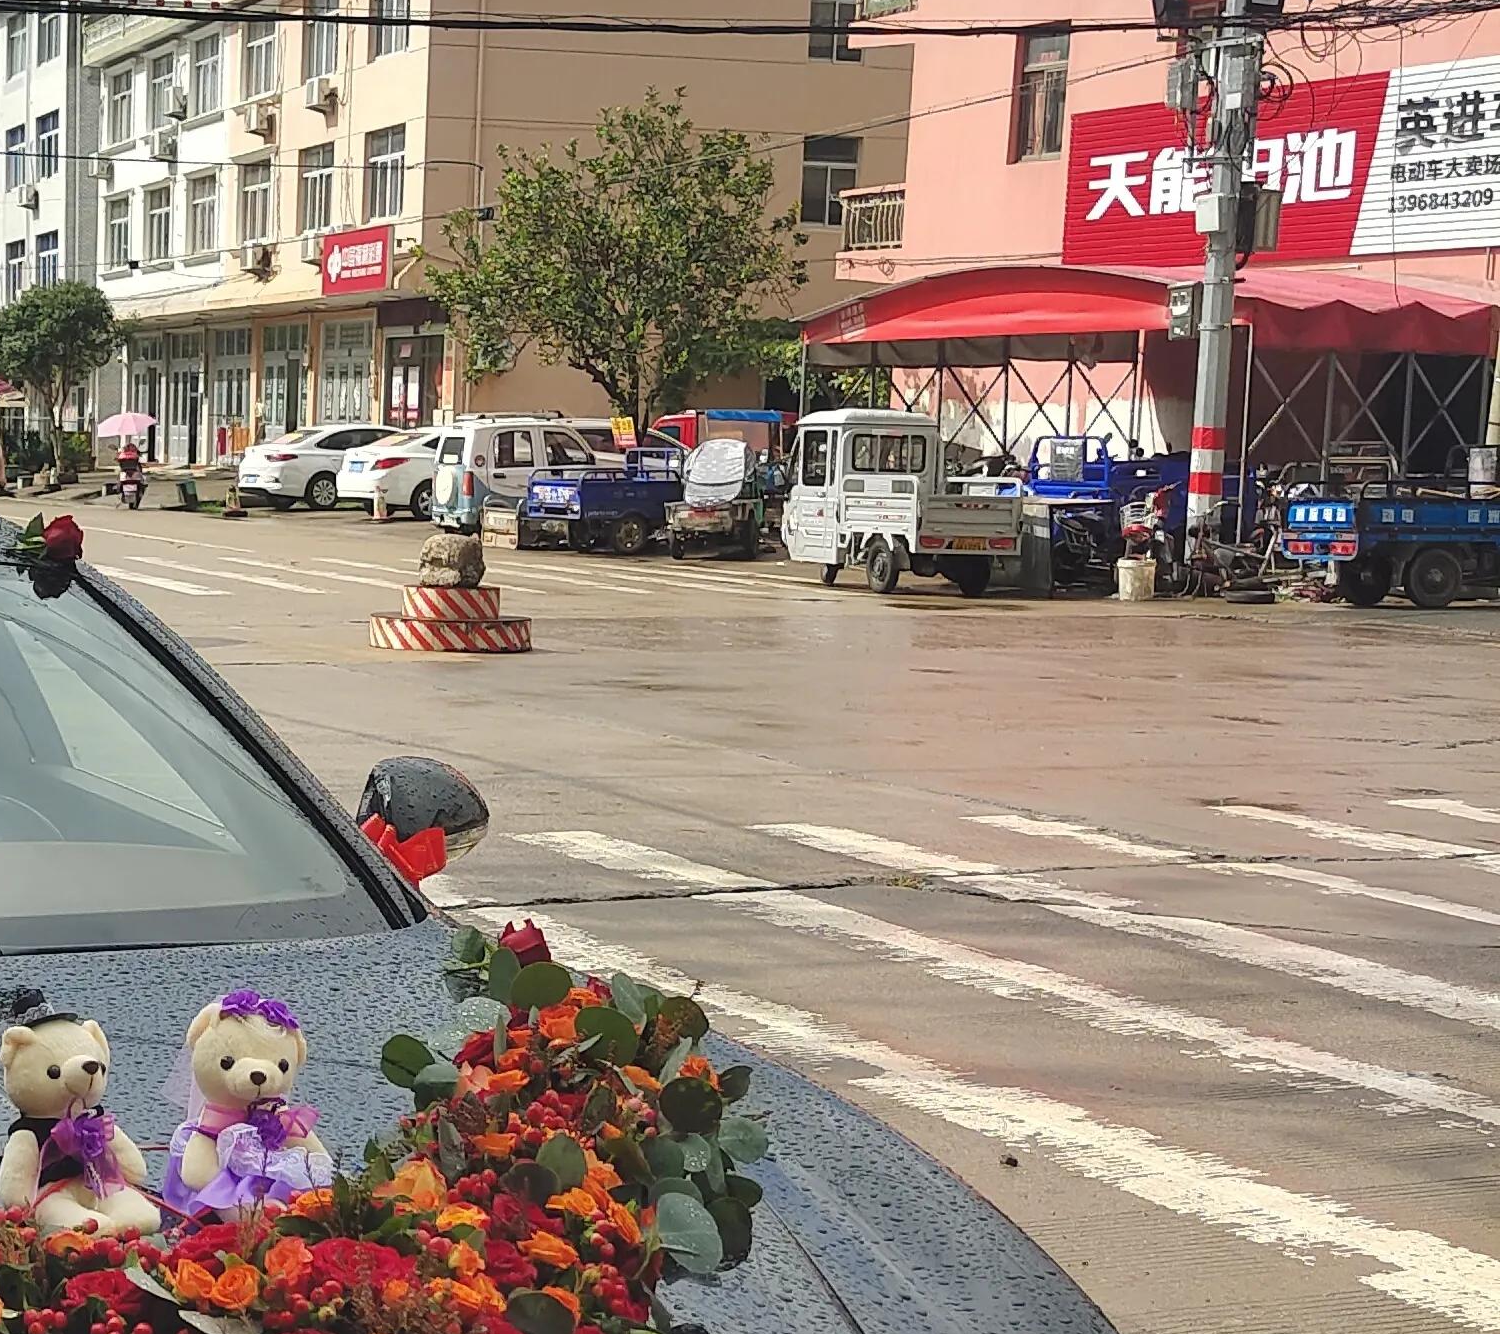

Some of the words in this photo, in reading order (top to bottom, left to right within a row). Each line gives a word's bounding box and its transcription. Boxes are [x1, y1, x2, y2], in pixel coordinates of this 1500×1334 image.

[1395, 90, 1500, 155] 英进
[1390, 154, 1500, 184] 电动车大卖场
